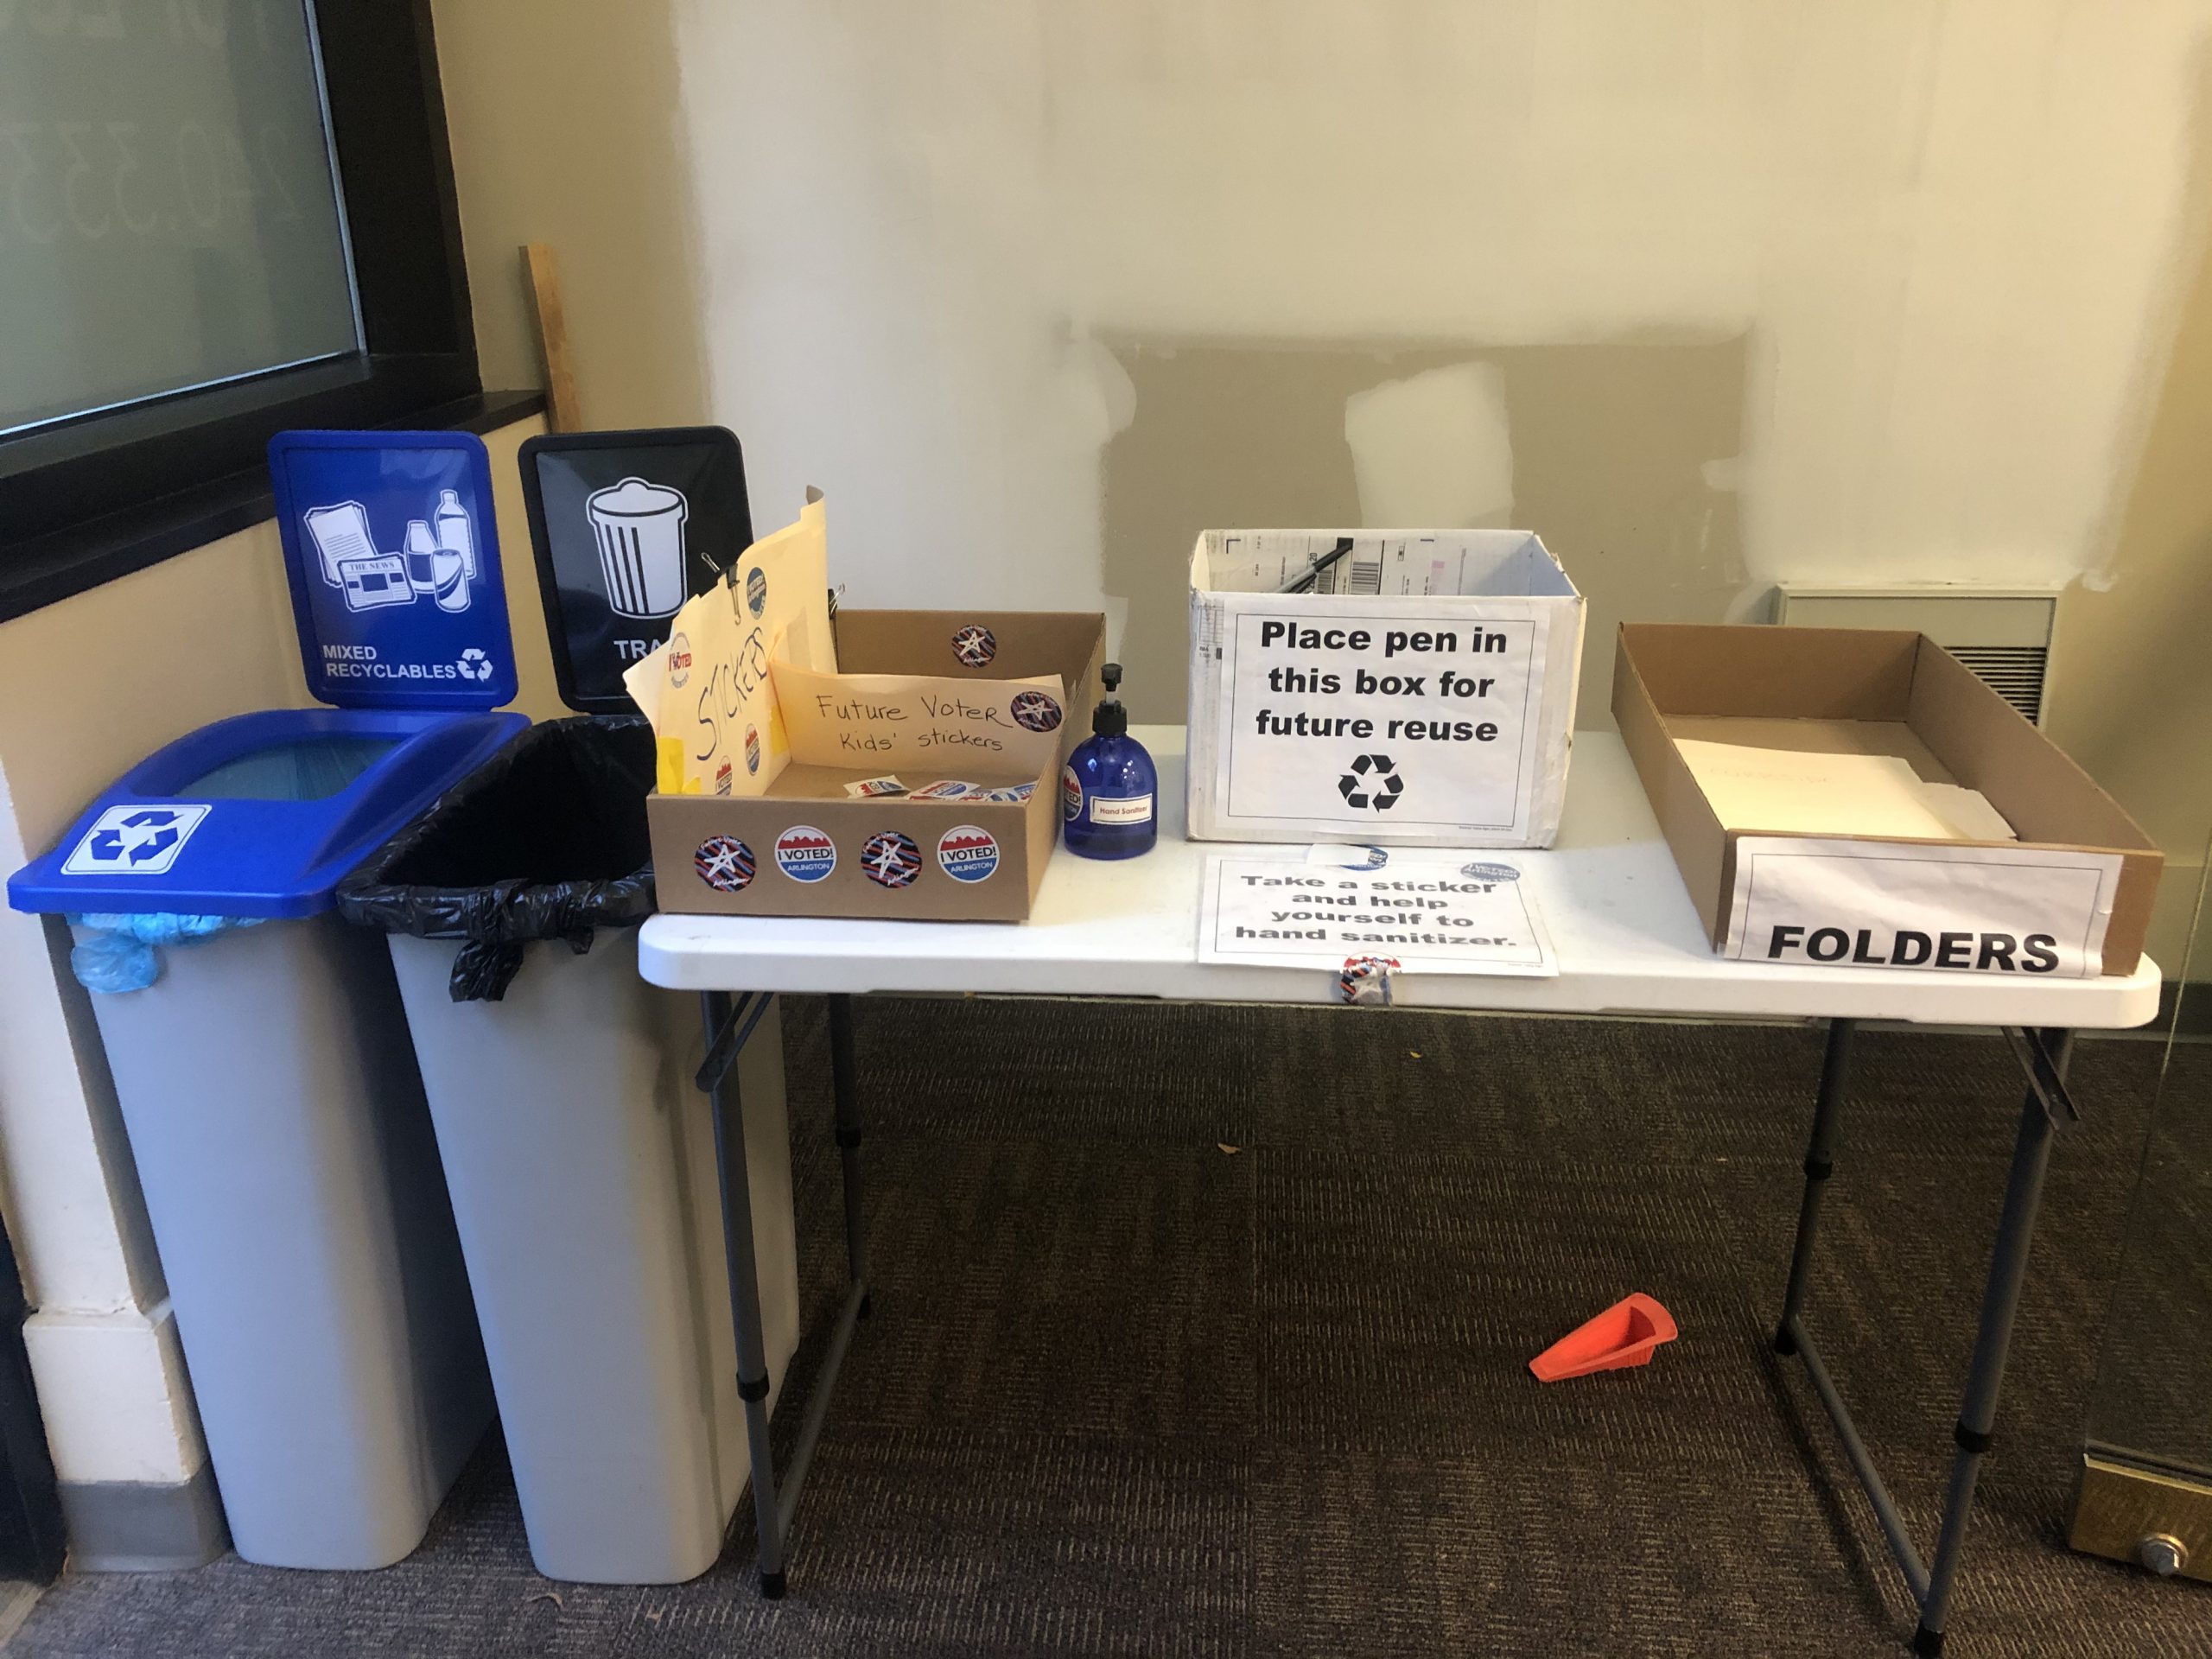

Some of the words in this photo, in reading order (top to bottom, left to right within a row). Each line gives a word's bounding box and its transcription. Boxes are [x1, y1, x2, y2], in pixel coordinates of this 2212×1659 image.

[349, 563, 365, 571] THE
[369, 560, 395, 569] NEWS
[1262, 621, 1371, 650] Place
[1385, 632, 1457, 658] pen
[1472, 626, 1507, 652] in
[322, 645, 377, 660] MIXED
[613, 639, 662, 659] TRA
[327, 663, 456, 679] RECYCLABLES
[1268, 667, 1340, 693] this
[1355, 669, 1426, 696] box
[1439, 671, 1495, 697] for
[817, 695, 907, 721] Future
[1256, 709, 1374, 738] future
[1388, 721, 1498, 741] reuse
[918, 728, 1003, 751] stickers
[778, 851, 782, 861] I
[785, 849, 834, 861] VOTED!
[940, 852, 944, 862] I
[947, 847, 997, 861] VOTED!
[787, 862, 830, 872] ARLINGTON
[950, 861, 993, 873] ARLINGTON
[1241, 875, 1325, 887] Take
[1371, 881, 1497, 893] sticker
[1293, 893, 1357, 906] and
[1370, 896, 1448, 909] help
[1271, 911, 1422, 925] yourself
[1436, 915, 1474, 927] to
[1236, 926, 1326, 940] hand
[1341, 931, 1516, 946] sanitizer.
[1767, 925, 2060, 972] FOLDERS
